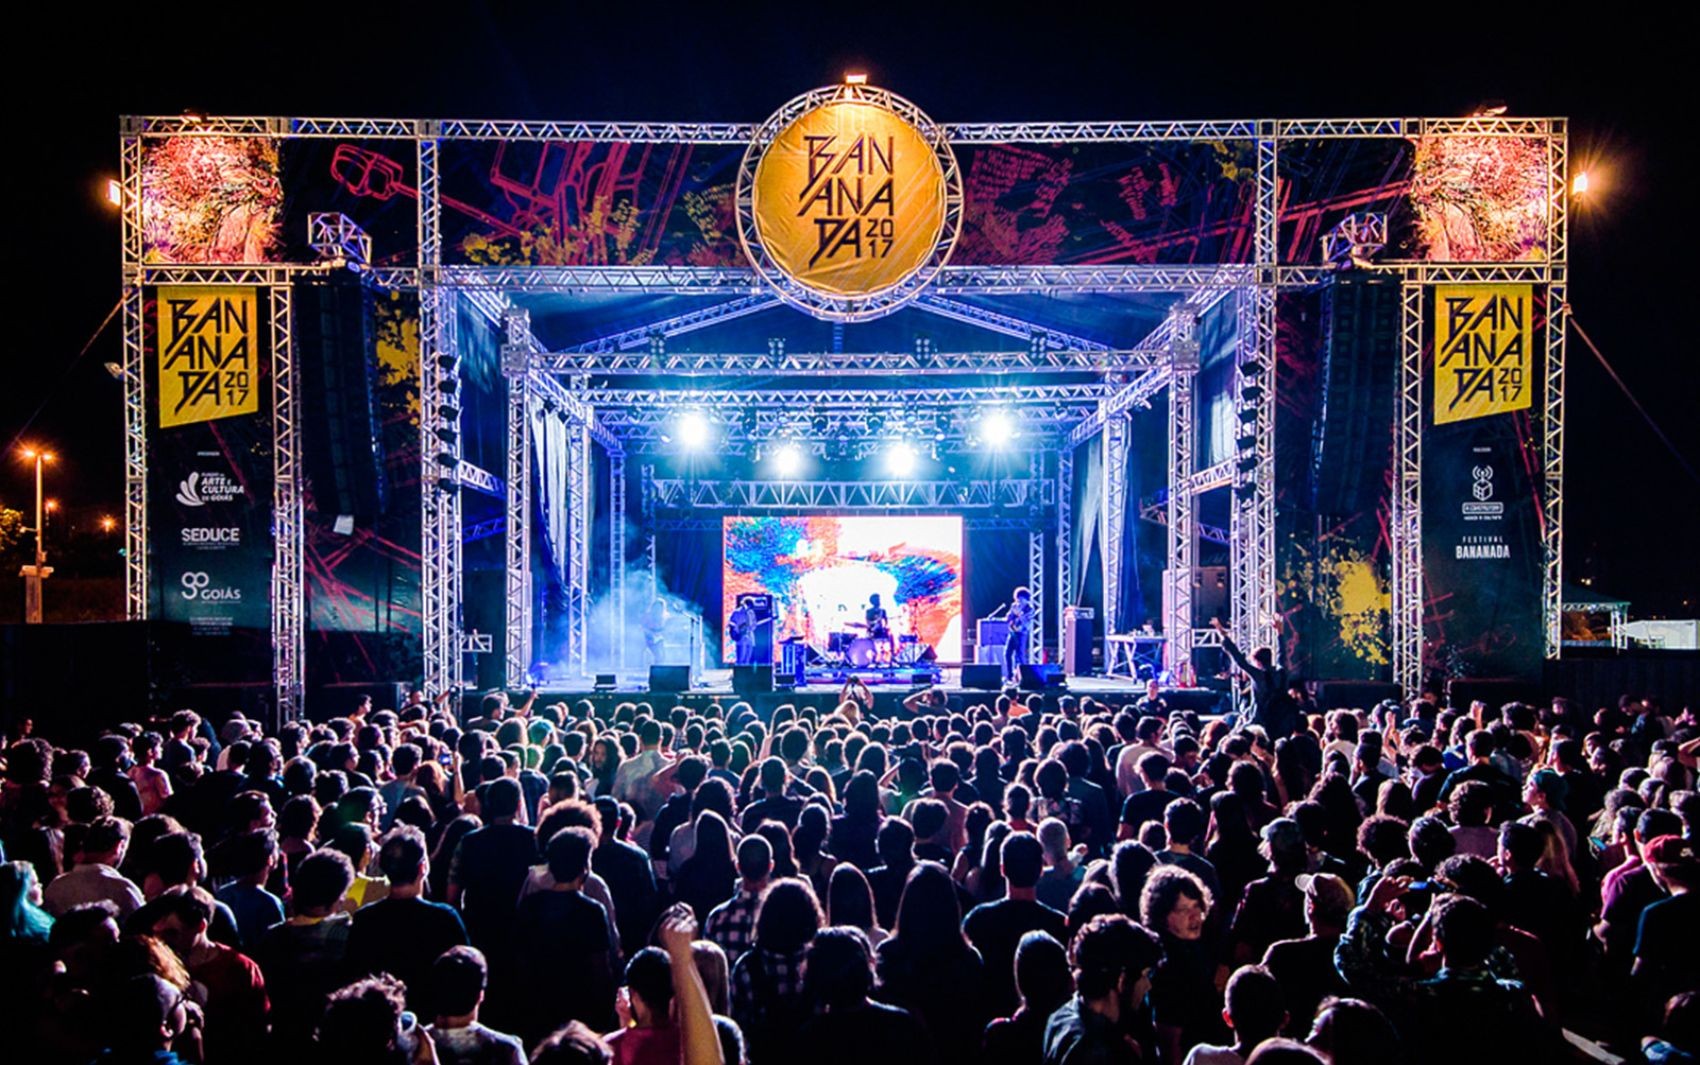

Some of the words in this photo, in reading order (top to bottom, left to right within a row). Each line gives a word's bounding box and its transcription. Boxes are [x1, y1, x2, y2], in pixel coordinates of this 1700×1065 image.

[201, 477, 226, 485] ARTE
[201, 485, 245, 494] CULTURA
[181, 527, 240, 542] SEDUCE
[1455, 545, 1510, 559] BANANADA
[200, 587, 241, 600] GOIÁS
